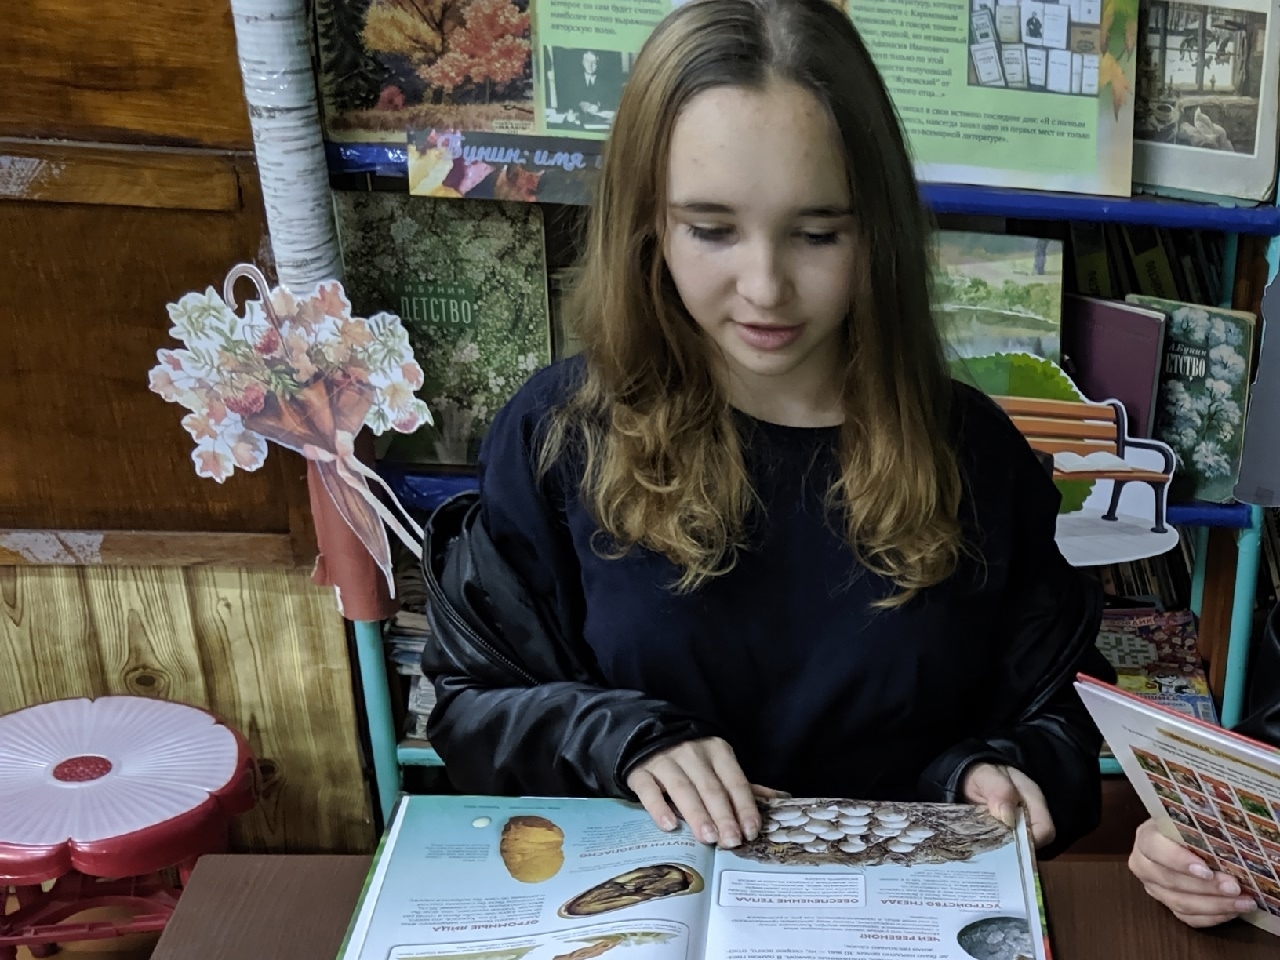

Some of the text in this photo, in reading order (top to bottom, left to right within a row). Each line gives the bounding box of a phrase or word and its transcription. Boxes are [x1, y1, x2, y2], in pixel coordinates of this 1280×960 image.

[533, 149, 587, 172] имя
[400, 296, 472, 324] ДЕТСТВО
[1165, 353, 1206, 378] ЕТСТВО
[880, 899, 1002, 910] УСТРОЙСТВО ГНЕЗДА
[432, 919, 540, 933] ОГРОМНЫЕ ЯЙЦА
